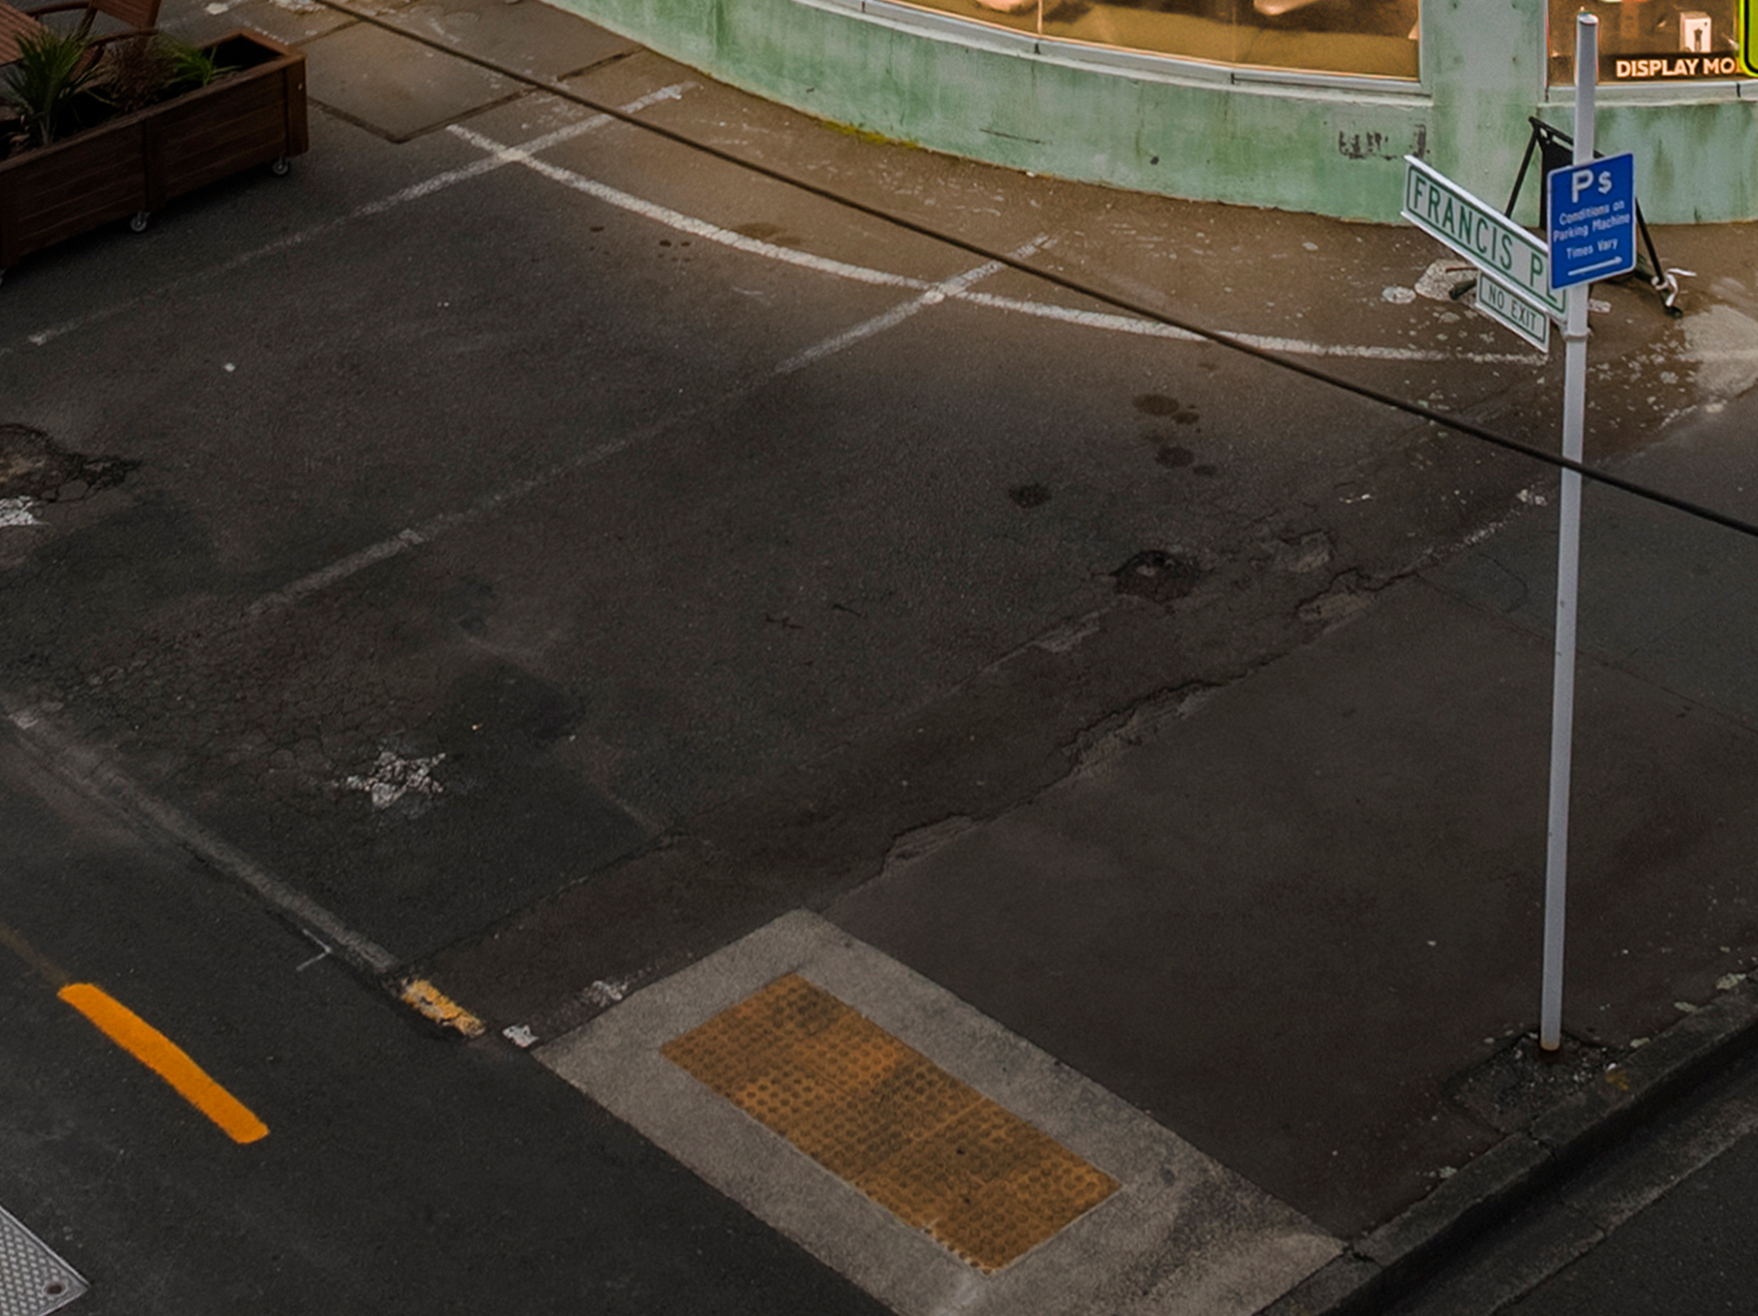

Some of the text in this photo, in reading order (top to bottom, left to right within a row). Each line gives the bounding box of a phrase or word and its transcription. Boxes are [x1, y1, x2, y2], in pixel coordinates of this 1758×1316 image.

[1615, 58, 1698, 78] DISPLAY
[1414, 176, 1513, 272] FRANCIS
[1559, 200, 1625, 226] Conditions on
[1553, 213, 1631, 243] Parking Machine
[1566, 238, 1618, 260] Times Vary
[1488, 284, 1537, 331] NO EXIT
